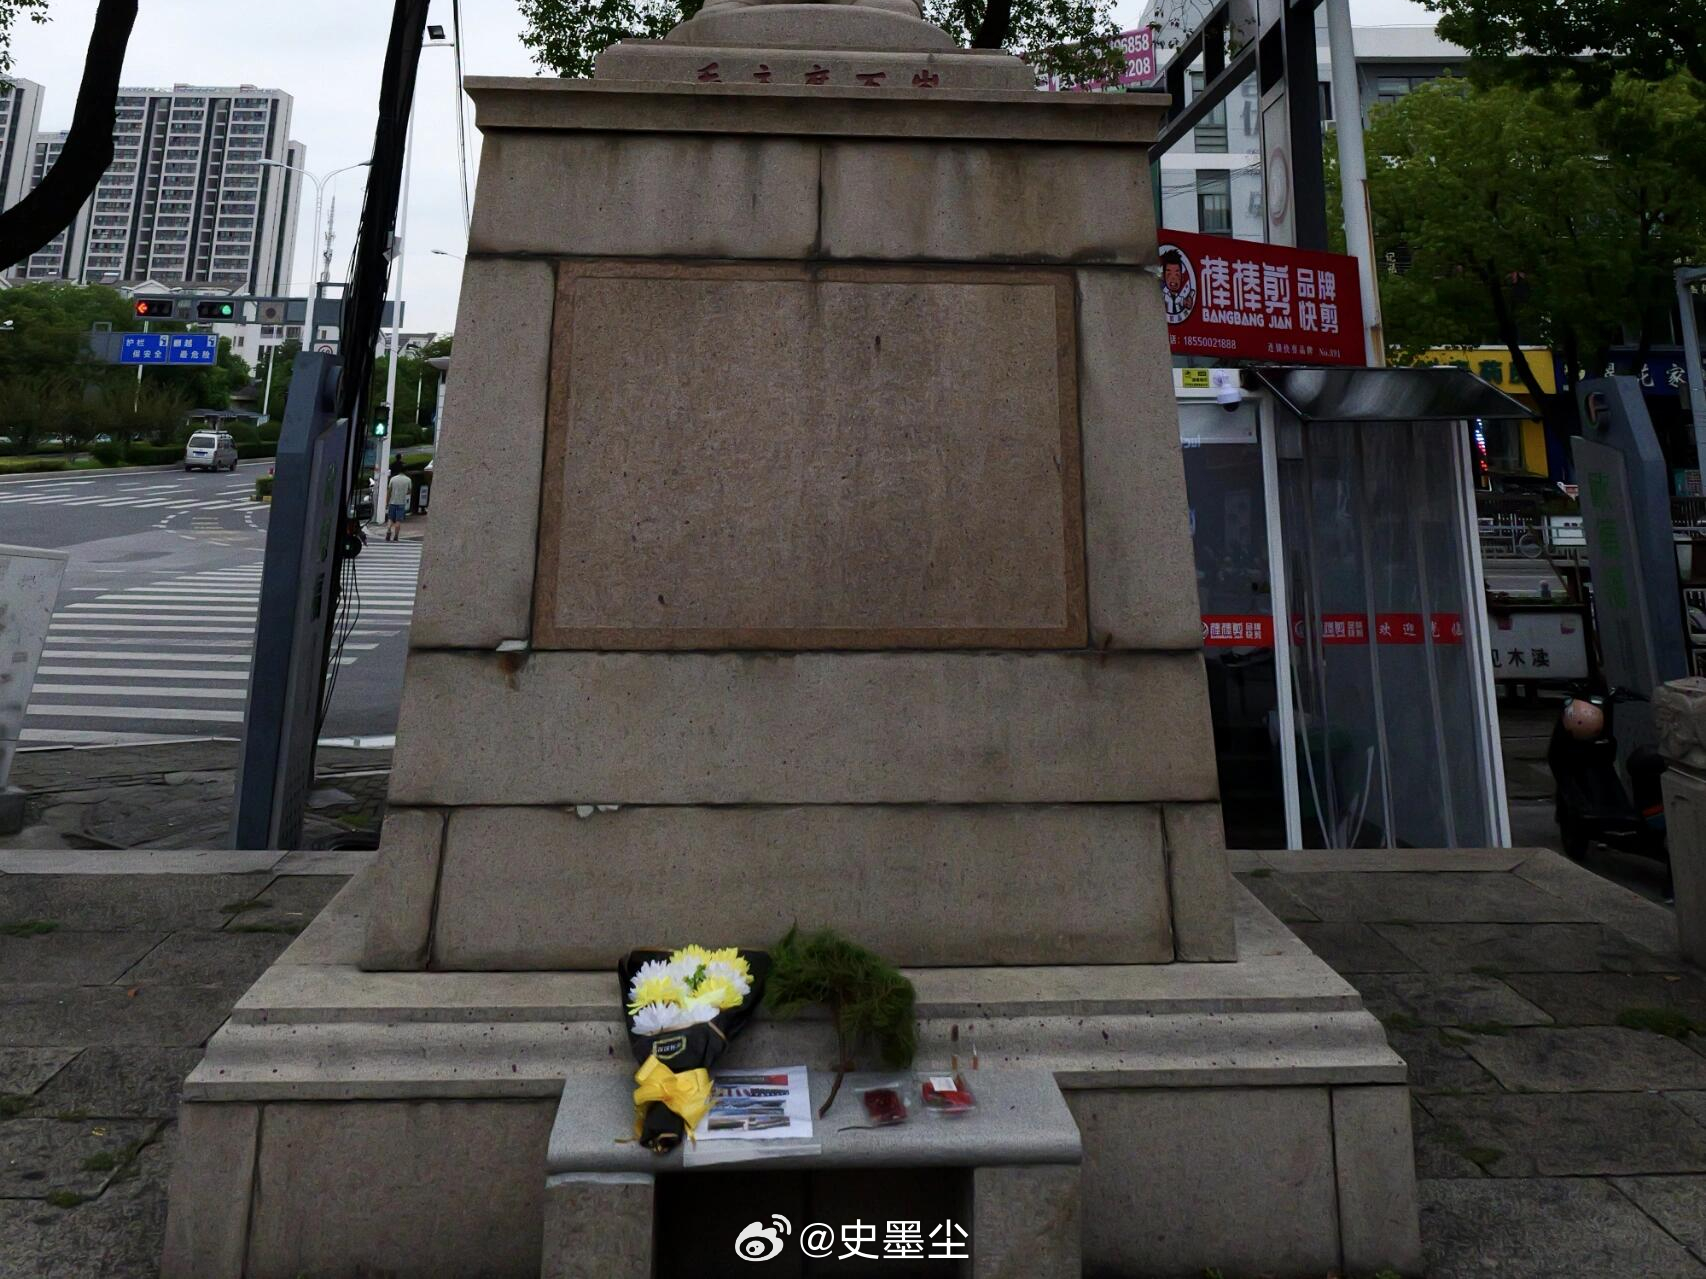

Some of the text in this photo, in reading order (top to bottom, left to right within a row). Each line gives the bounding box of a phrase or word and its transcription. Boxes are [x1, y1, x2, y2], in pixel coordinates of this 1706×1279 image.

[1200, 254, 1291, 316] 棒棒剪
[1296, 267, 1336, 302] 品牌
[1202, 308, 1264, 328] BANGBANG
[1268, 315, 1293, 330] JIAN
[1298, 300, 1339, 335] 快剪
